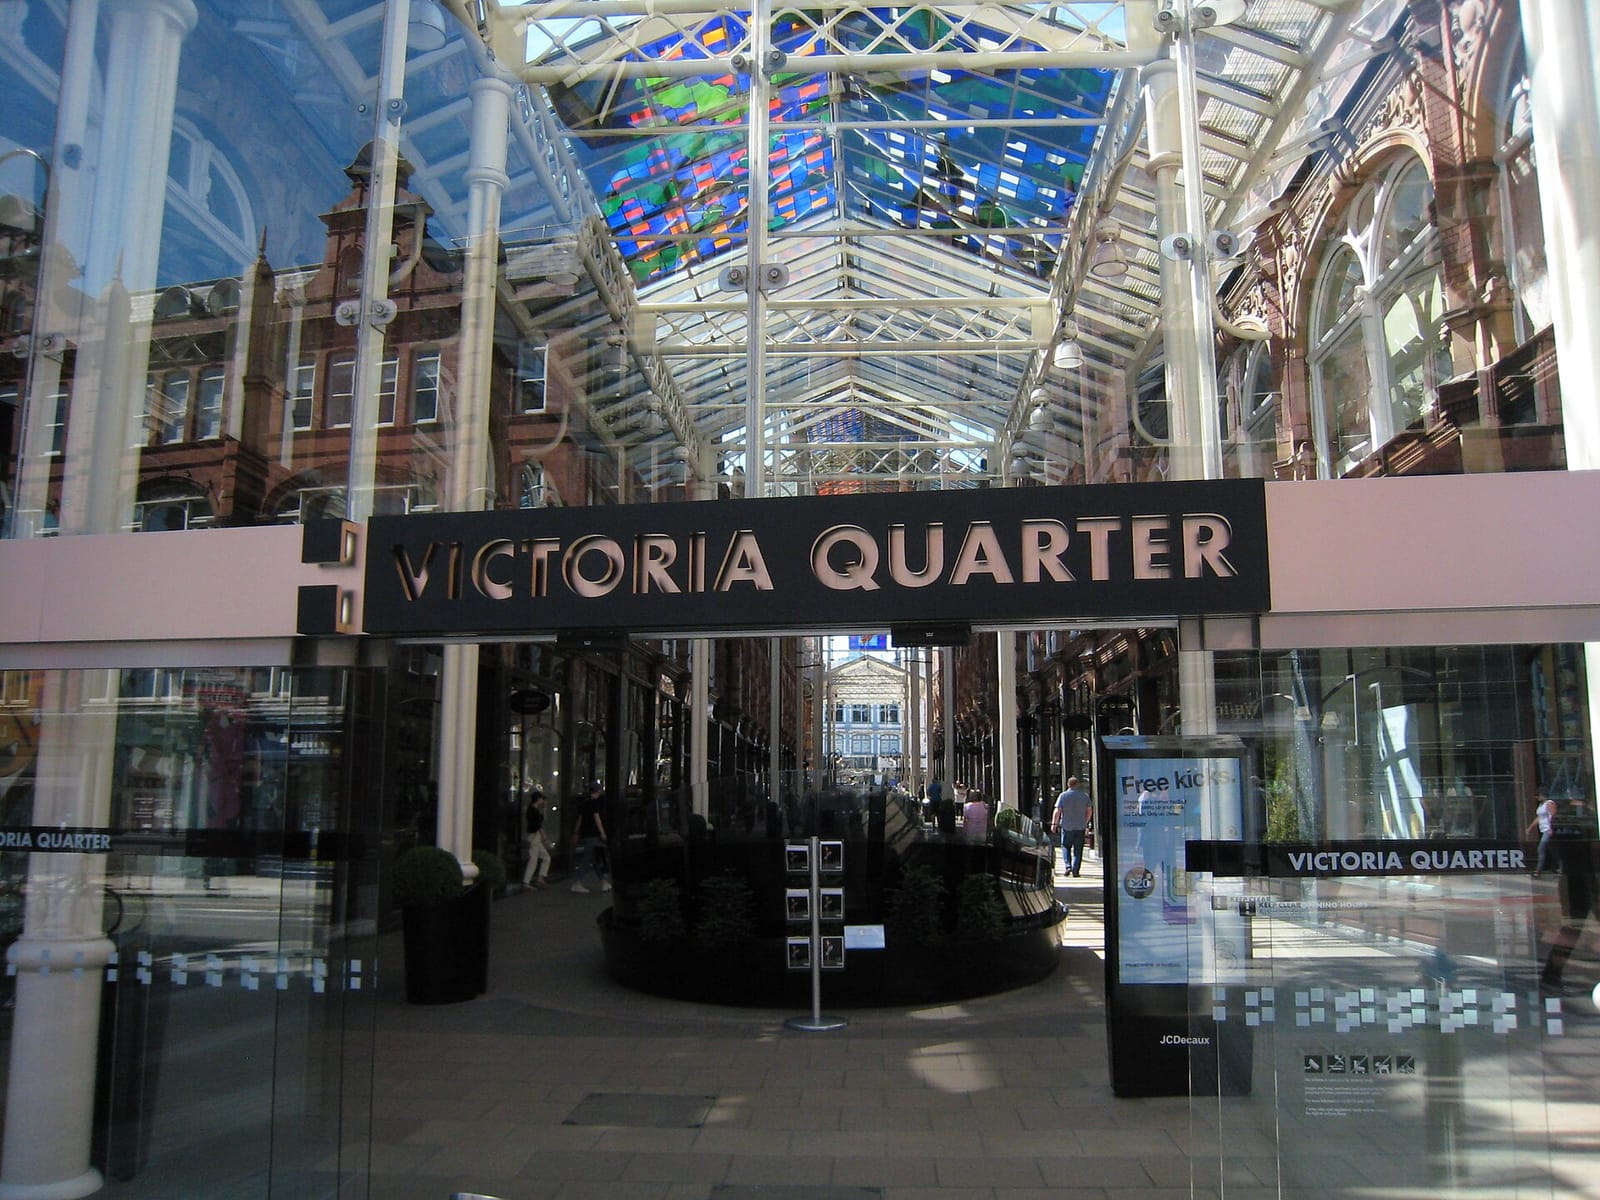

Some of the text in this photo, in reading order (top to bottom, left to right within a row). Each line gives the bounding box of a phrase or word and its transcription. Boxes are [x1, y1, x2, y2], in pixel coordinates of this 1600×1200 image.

[392, 513, 1239, 600] VICTORIA QUARTER
[1121, 775, 1170, 795] Free
[37, 832, 111, 849] QUARTER
[1288, 850, 1526, 871] VICTORIA QUARTER
[1159, 1035, 1210, 1045] JCDecaux
